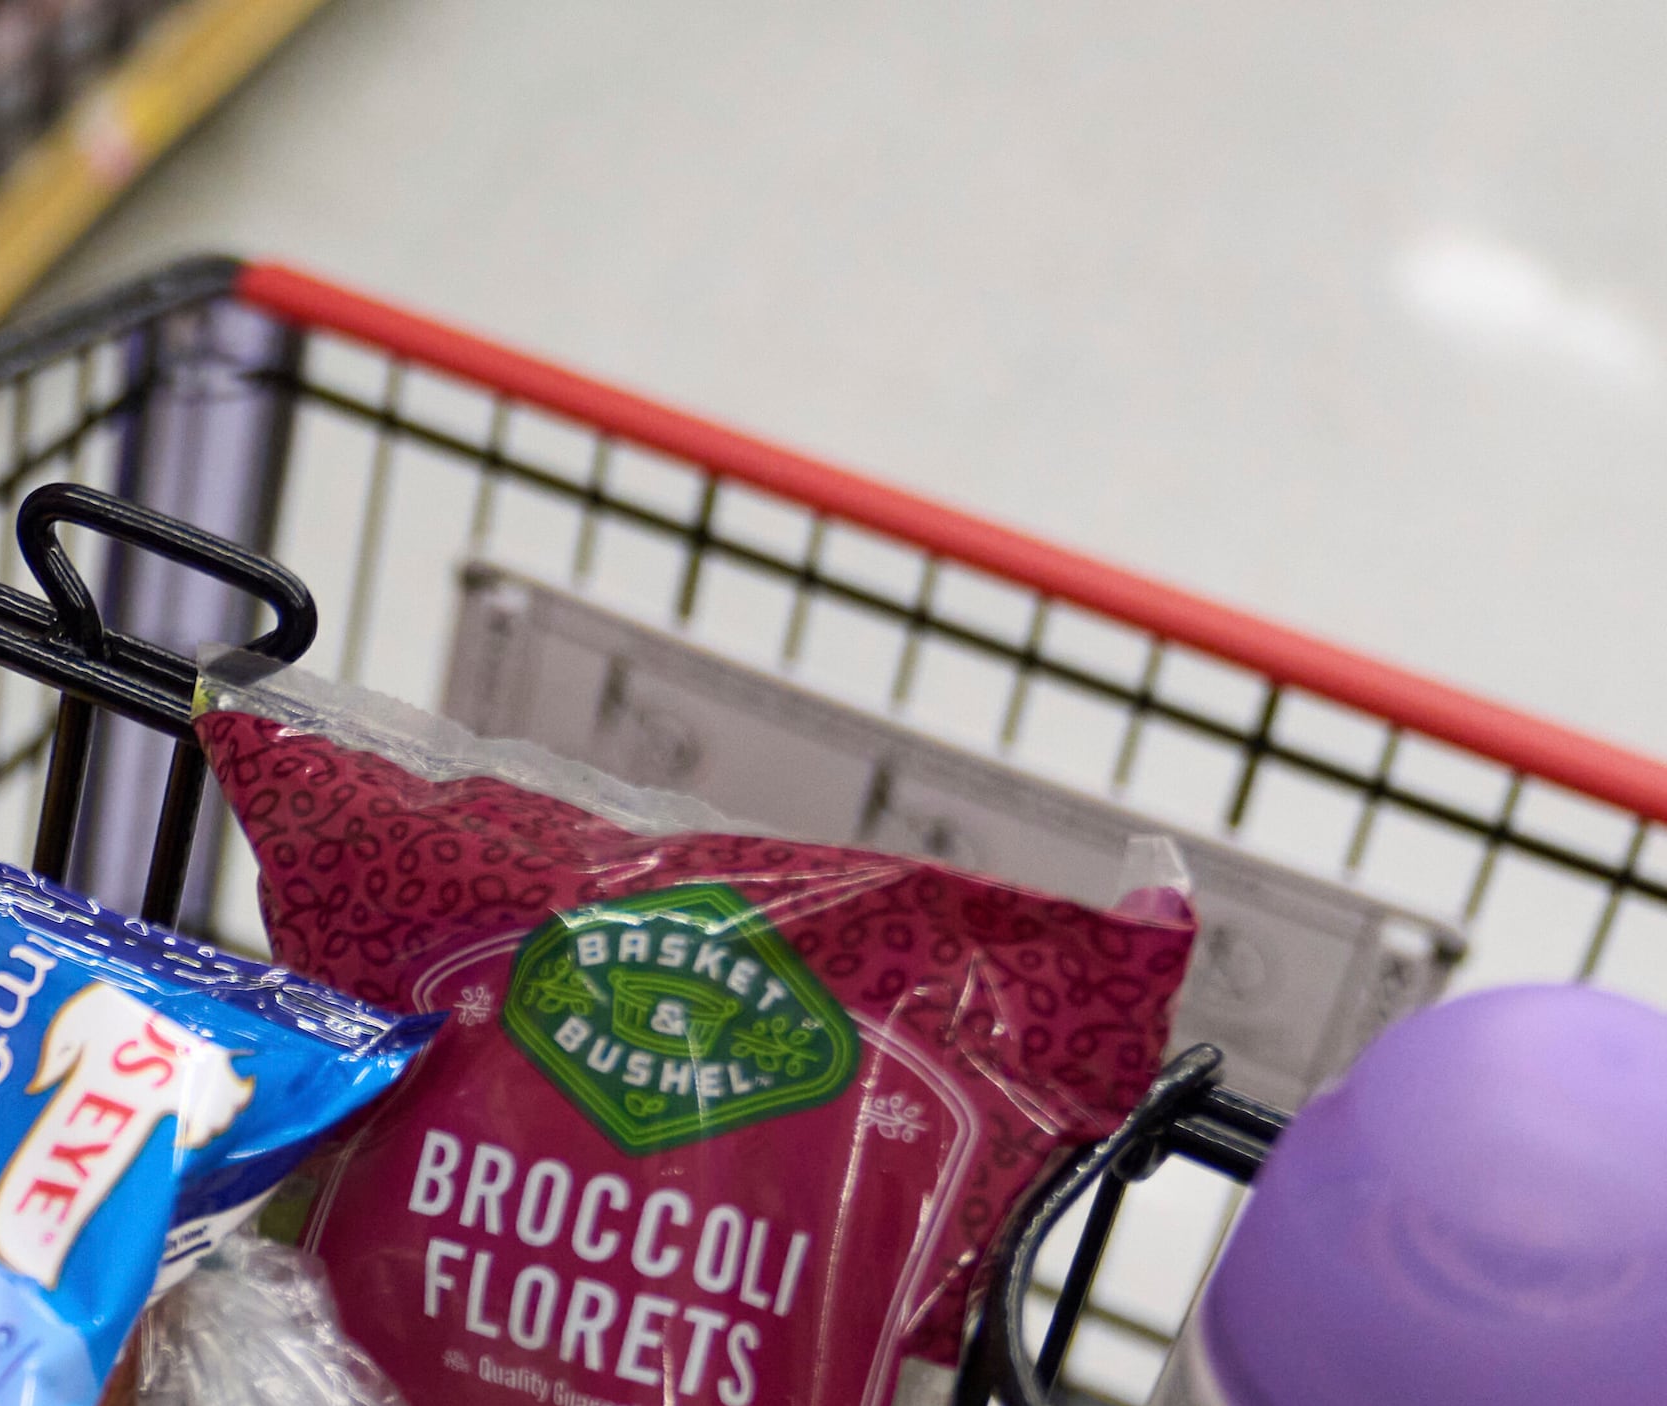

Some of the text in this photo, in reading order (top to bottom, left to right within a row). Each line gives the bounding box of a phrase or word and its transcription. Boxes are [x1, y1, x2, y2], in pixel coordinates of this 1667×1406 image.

[575, 929, 791, 1013] BASKET
[552, 1015, 755, 1097] BUSHEL
[648, 999, 690, 1038] &
[15, 1089, 139, 1222] EYE
[407, 1127, 811, 1319] BROCCOLI
[477, 1353, 551, 1403] Quality
